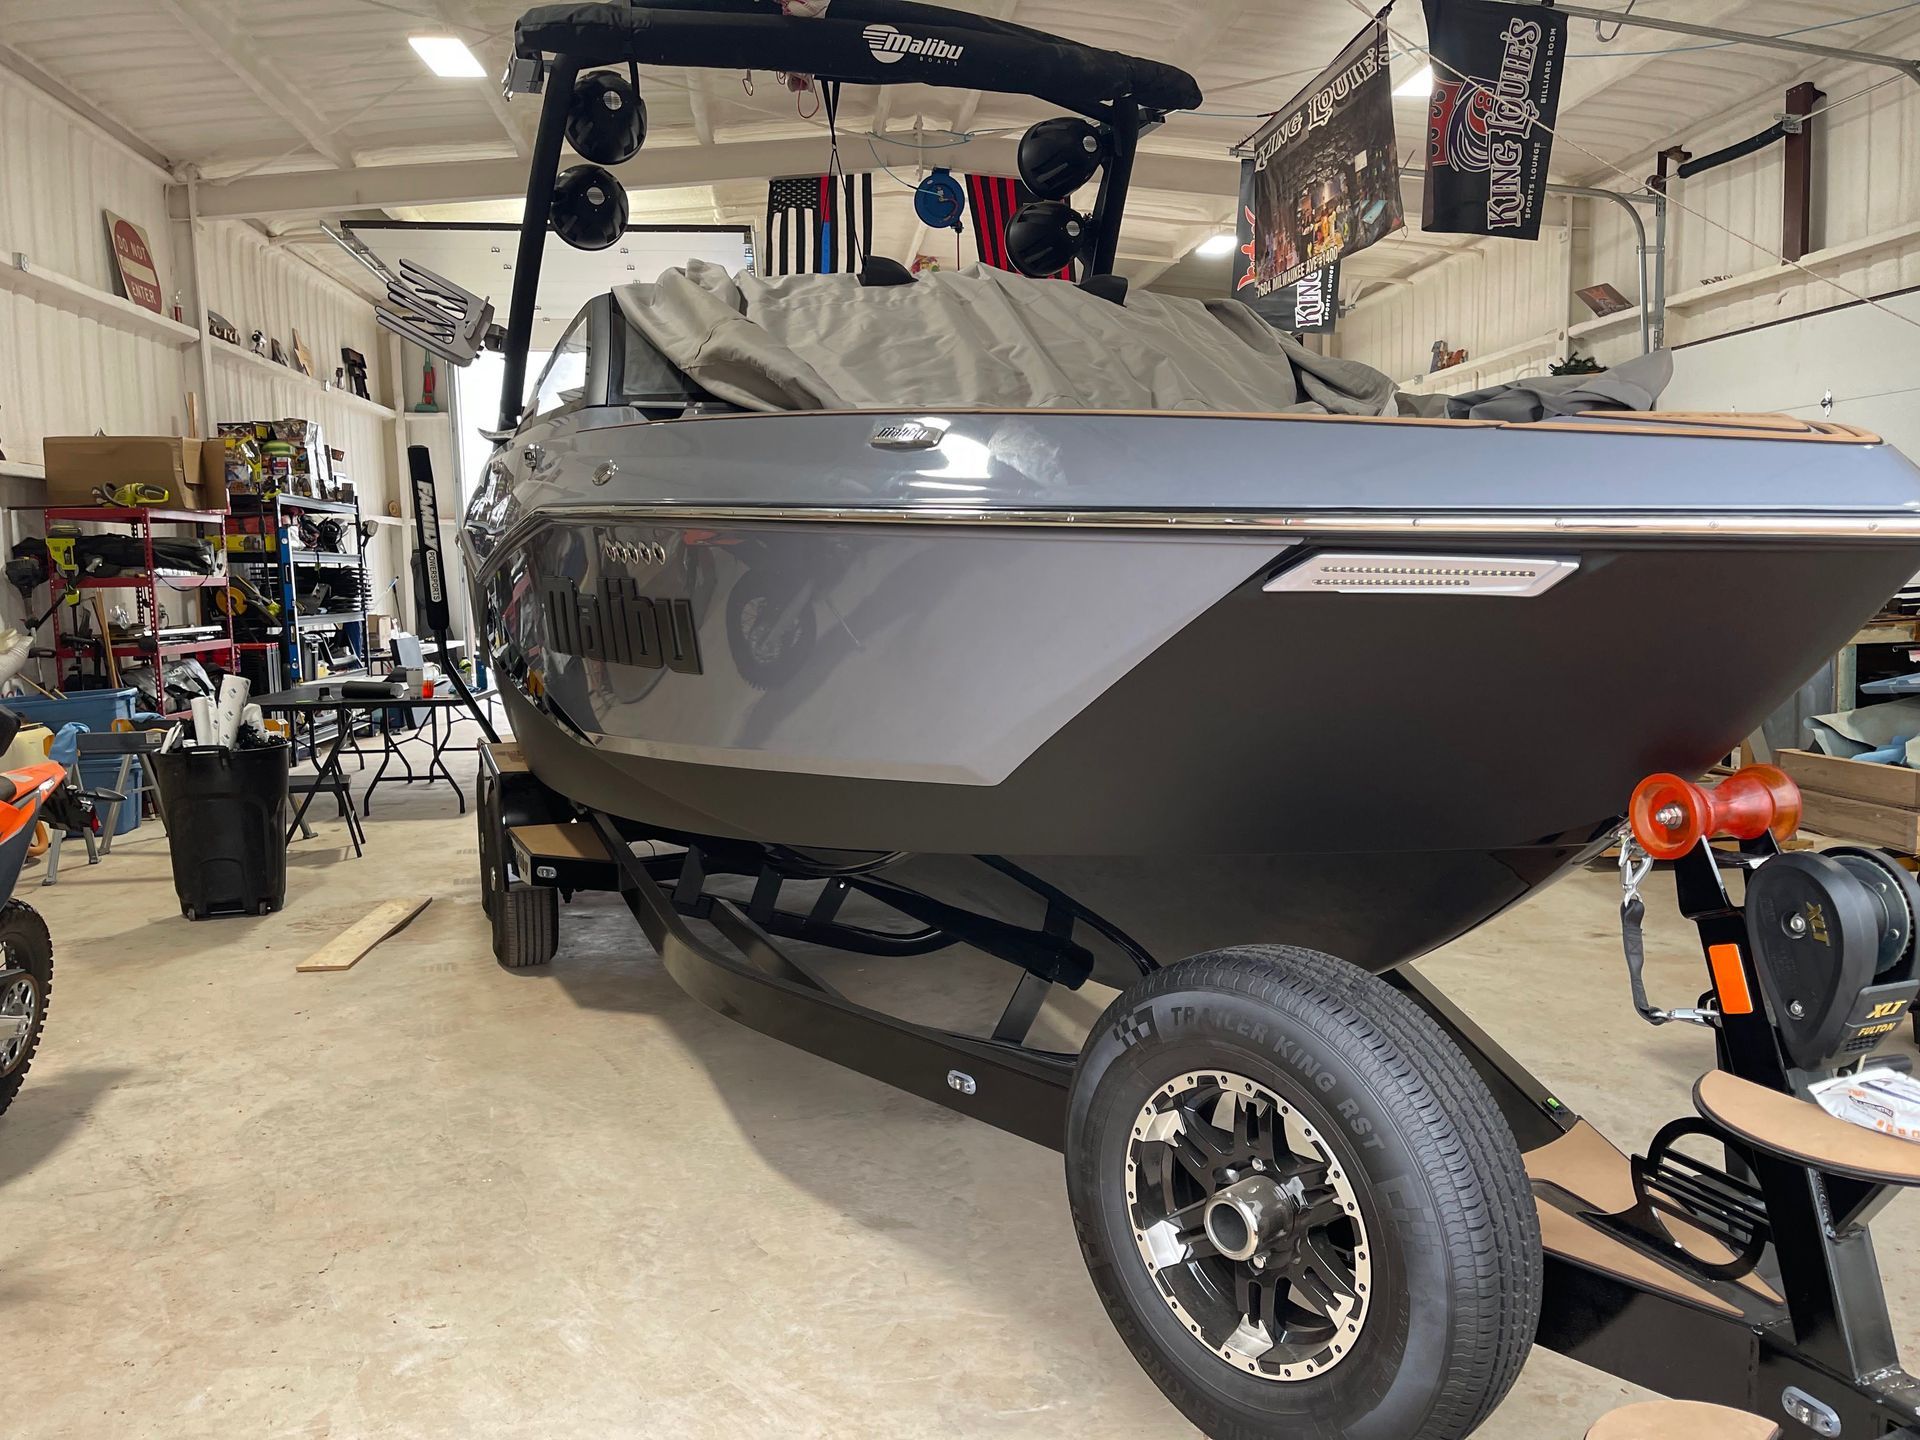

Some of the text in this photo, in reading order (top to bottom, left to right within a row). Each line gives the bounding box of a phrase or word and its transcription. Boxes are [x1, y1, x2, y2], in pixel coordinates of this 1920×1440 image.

[883, 33, 964, 60] Malibu
[919, 56, 958, 67] BOATS
[1540, 28, 1556, 104] BILLIARD ROOM
[1255, 111, 1302, 172] KING
[1484, 18, 1541, 229] KING LOUIE'S
[1524, 142, 1541, 219] SPORTS LOUNGE
[117, 235, 147, 262] DO NOT
[131, 281, 157, 305] ENTER
[1272, 265, 1306, 292] MILWAUKEE
[1324, 294, 1332, 320] SPORTS
[417, 480, 439, 552] FAMILY
[428, 551, 440, 600] POWERSPORTS
[540, 576, 703, 675] Malibu
[1806, 902, 1831, 946] XLT
[1858, 1022, 1896, 1036] FULTON
[1866, 1000, 1908, 1019] XLT
[1171, 1006, 1387, 1150] TRAILER KING RST
